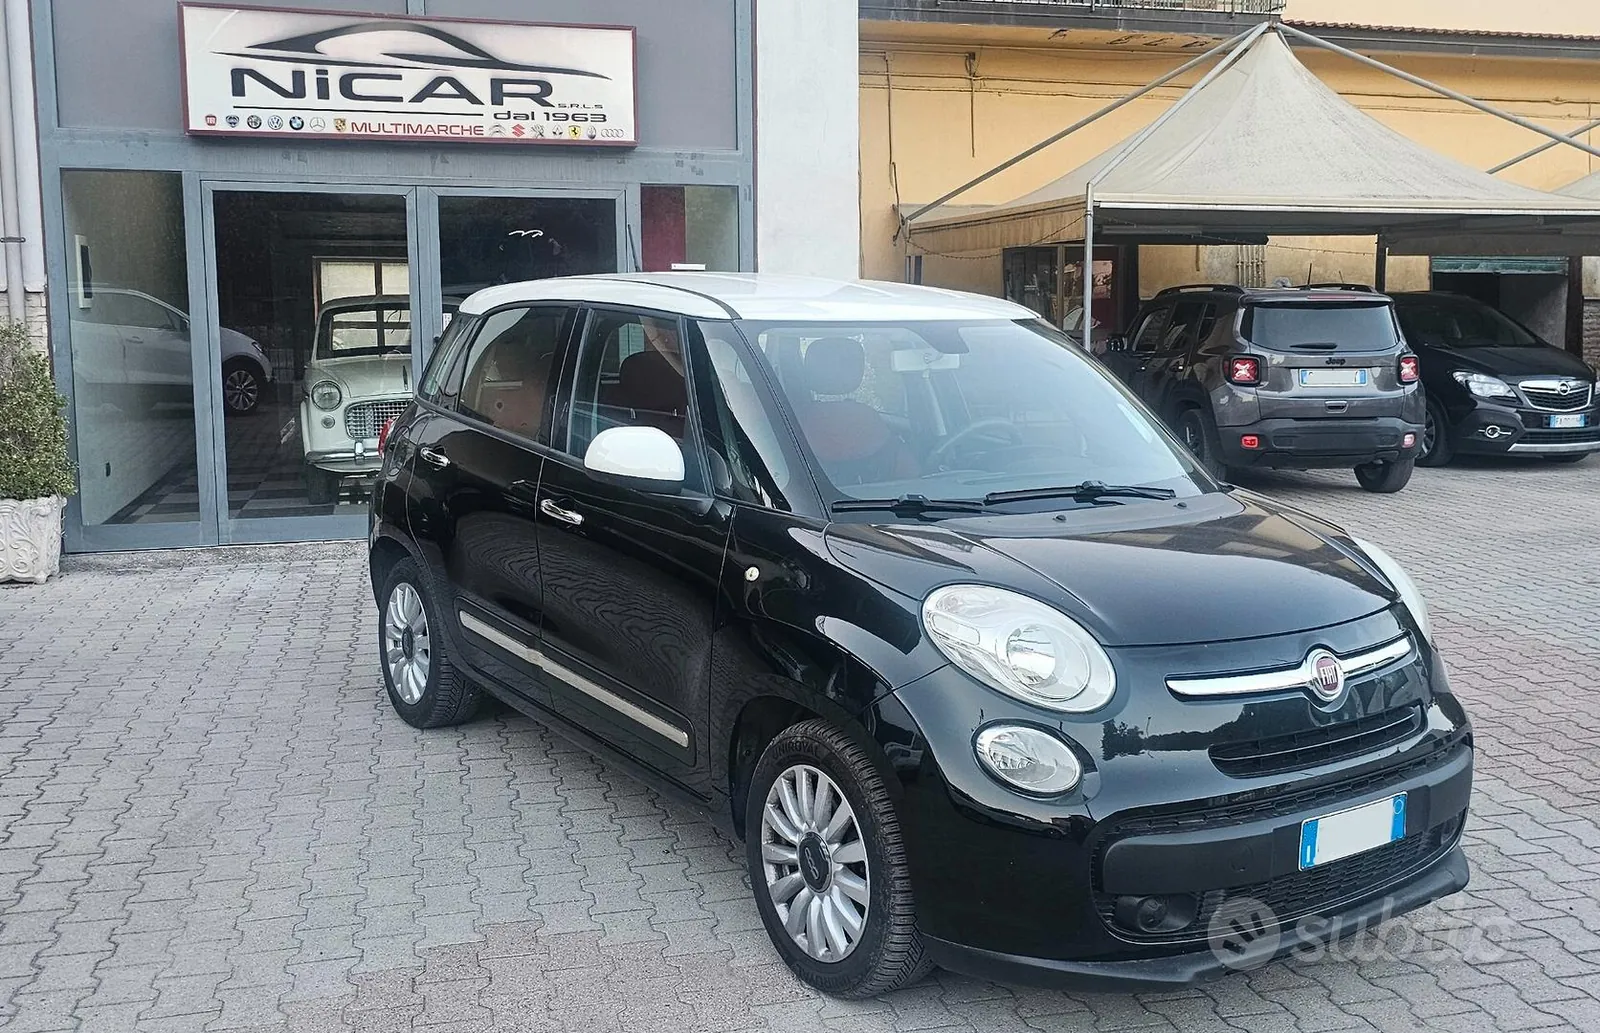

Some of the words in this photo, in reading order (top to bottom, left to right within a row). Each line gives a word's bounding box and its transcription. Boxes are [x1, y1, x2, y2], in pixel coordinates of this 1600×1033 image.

[493, 111, 535, 121] dal
[543, 112, 608, 123] 1963
[351, 122, 484, 136] MULTIMARCHE
[1325, 357, 1346, 366] Jeep
[1319, 664, 1338, 686] FIAT
[773, 738, 820, 759] UNIROYAL
